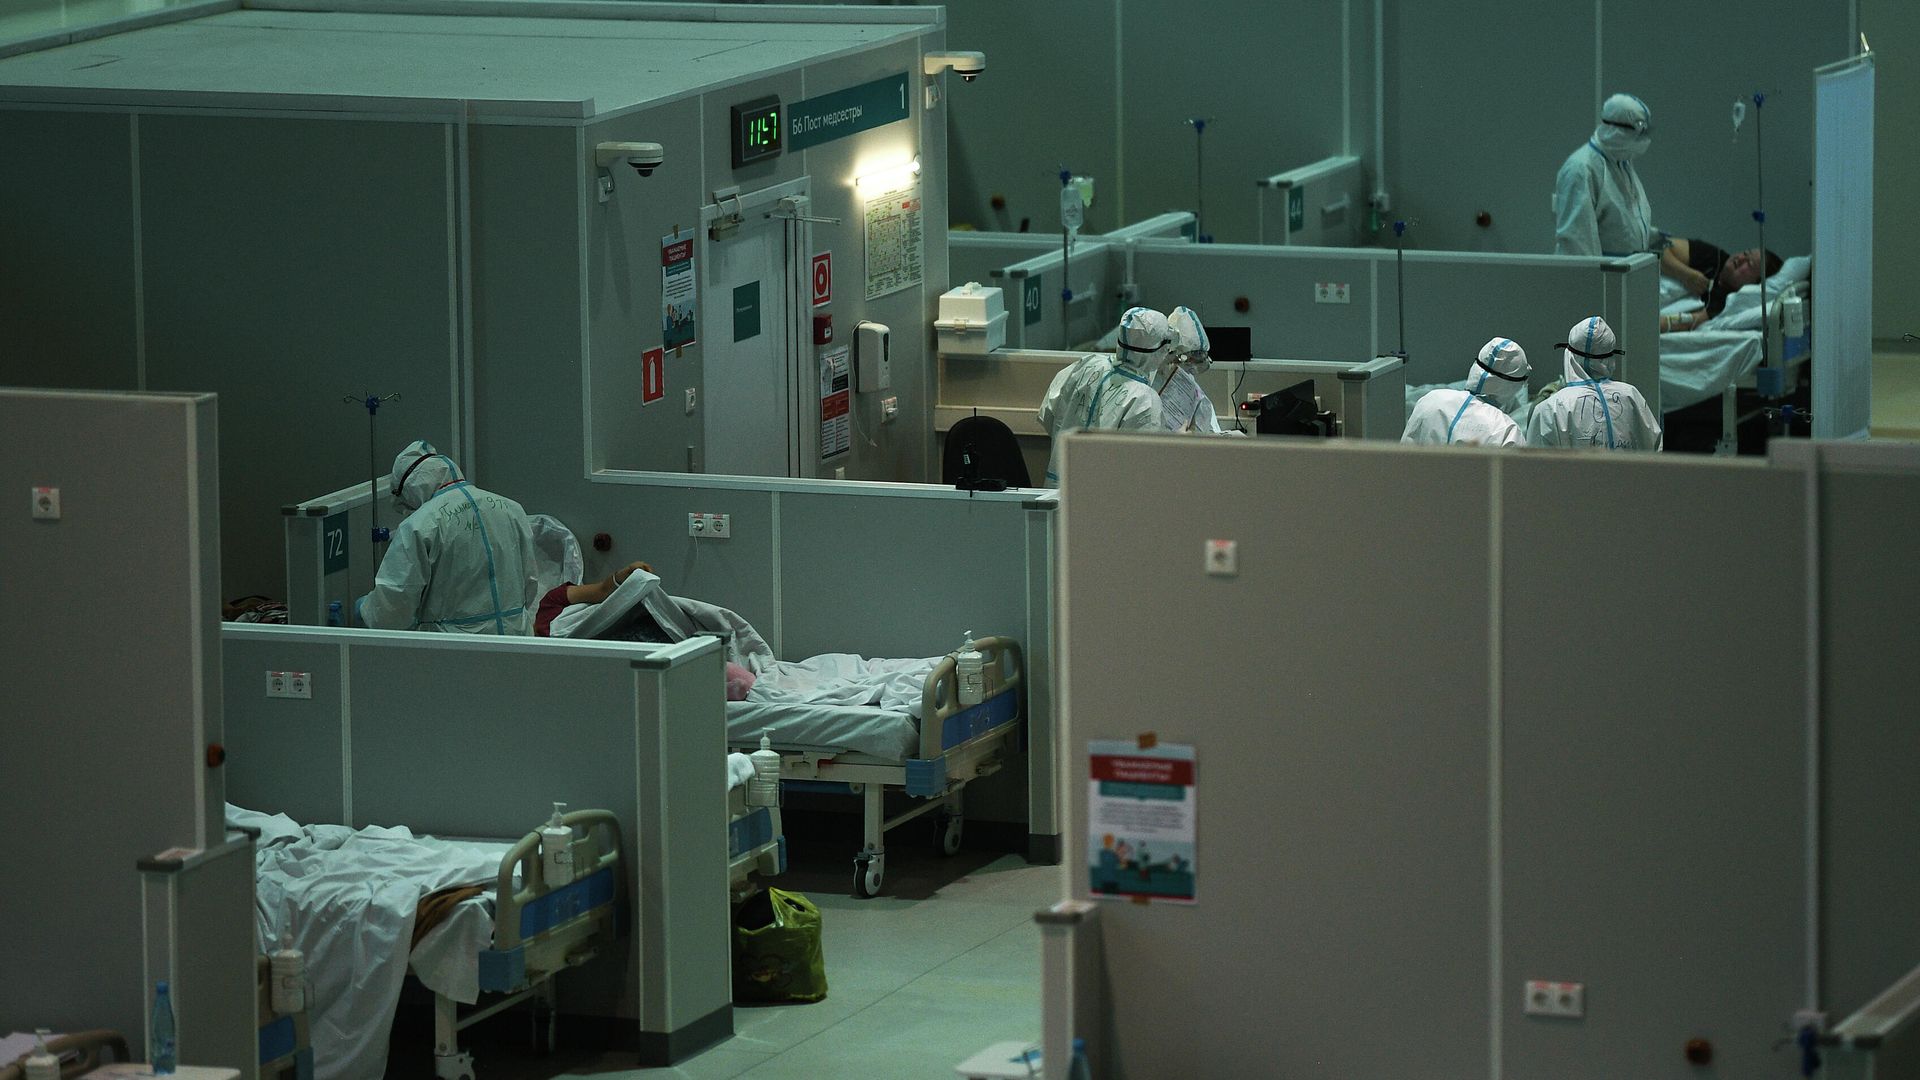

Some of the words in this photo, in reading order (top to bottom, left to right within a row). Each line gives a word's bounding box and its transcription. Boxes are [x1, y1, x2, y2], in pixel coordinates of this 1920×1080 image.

[899, 83, 905, 110] 1
[792, 118, 803, 135] Б6
[803, 115, 822, 132] Пост
[822, 104, 863, 127] медсестры
[1290, 198, 1301, 220] 44
[1026, 287, 1039, 312] 40
[327, 528, 344, 560] 72
